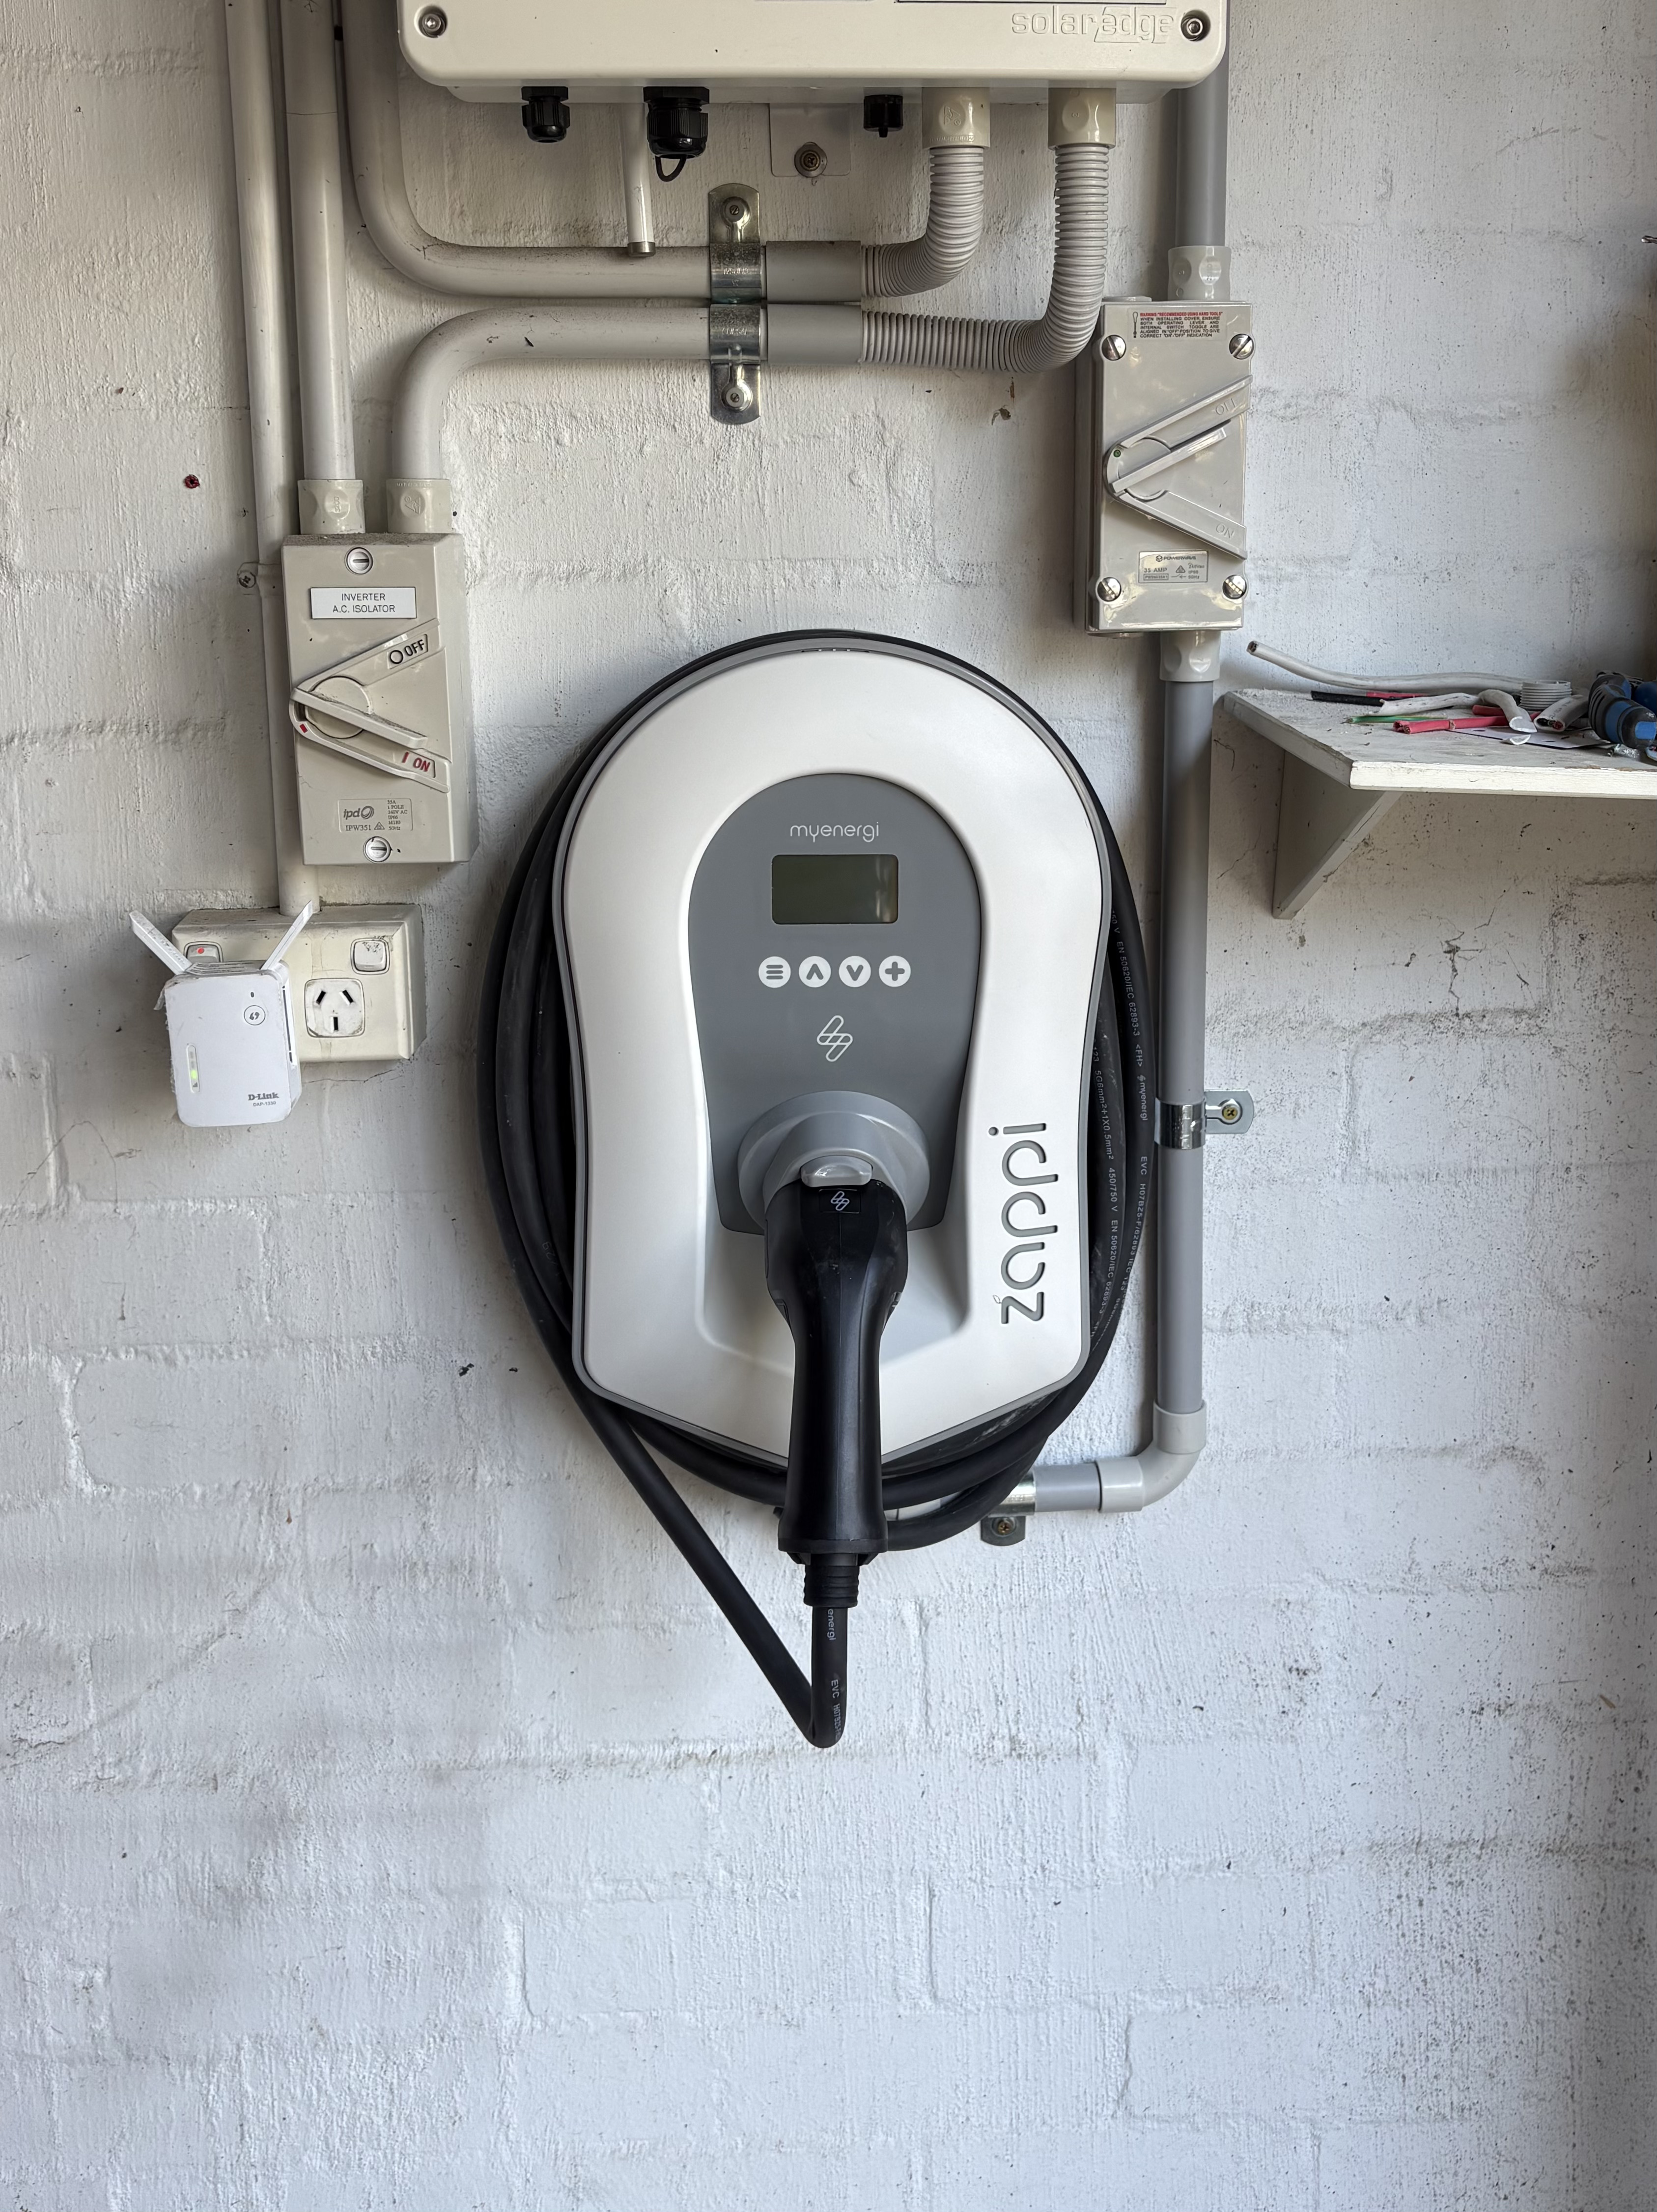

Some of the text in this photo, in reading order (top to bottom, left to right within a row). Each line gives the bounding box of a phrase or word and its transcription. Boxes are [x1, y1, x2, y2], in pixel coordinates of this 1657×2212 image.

[1012, 4, 1175, 43] solaredge
[404, 639, 424, 656] OFF
[413, 757, 430, 772] ON
[343, 808, 361, 820] ipd
[790, 822, 879, 843] myenergi
[1117, 941, 1125, 953] EN
[1120, 956, 1134, 999] 50620/IEC
[1129, 1002, 1140, 1036] 62893-3
[248, 1092, 280, 1101] D-Link
[1139, 1082, 1148, 1121] myenergi
[1108, 1167, 1118, 1202] 450/750
[988, 1123, 1059, 1324] zappi
[1111, 1220, 1118, 1232] EN
[1108, 1235, 1118, 1278] 50620/IEC
[827, 1608, 836, 1641] energi
[831, 1679, 840, 1699] EVC
